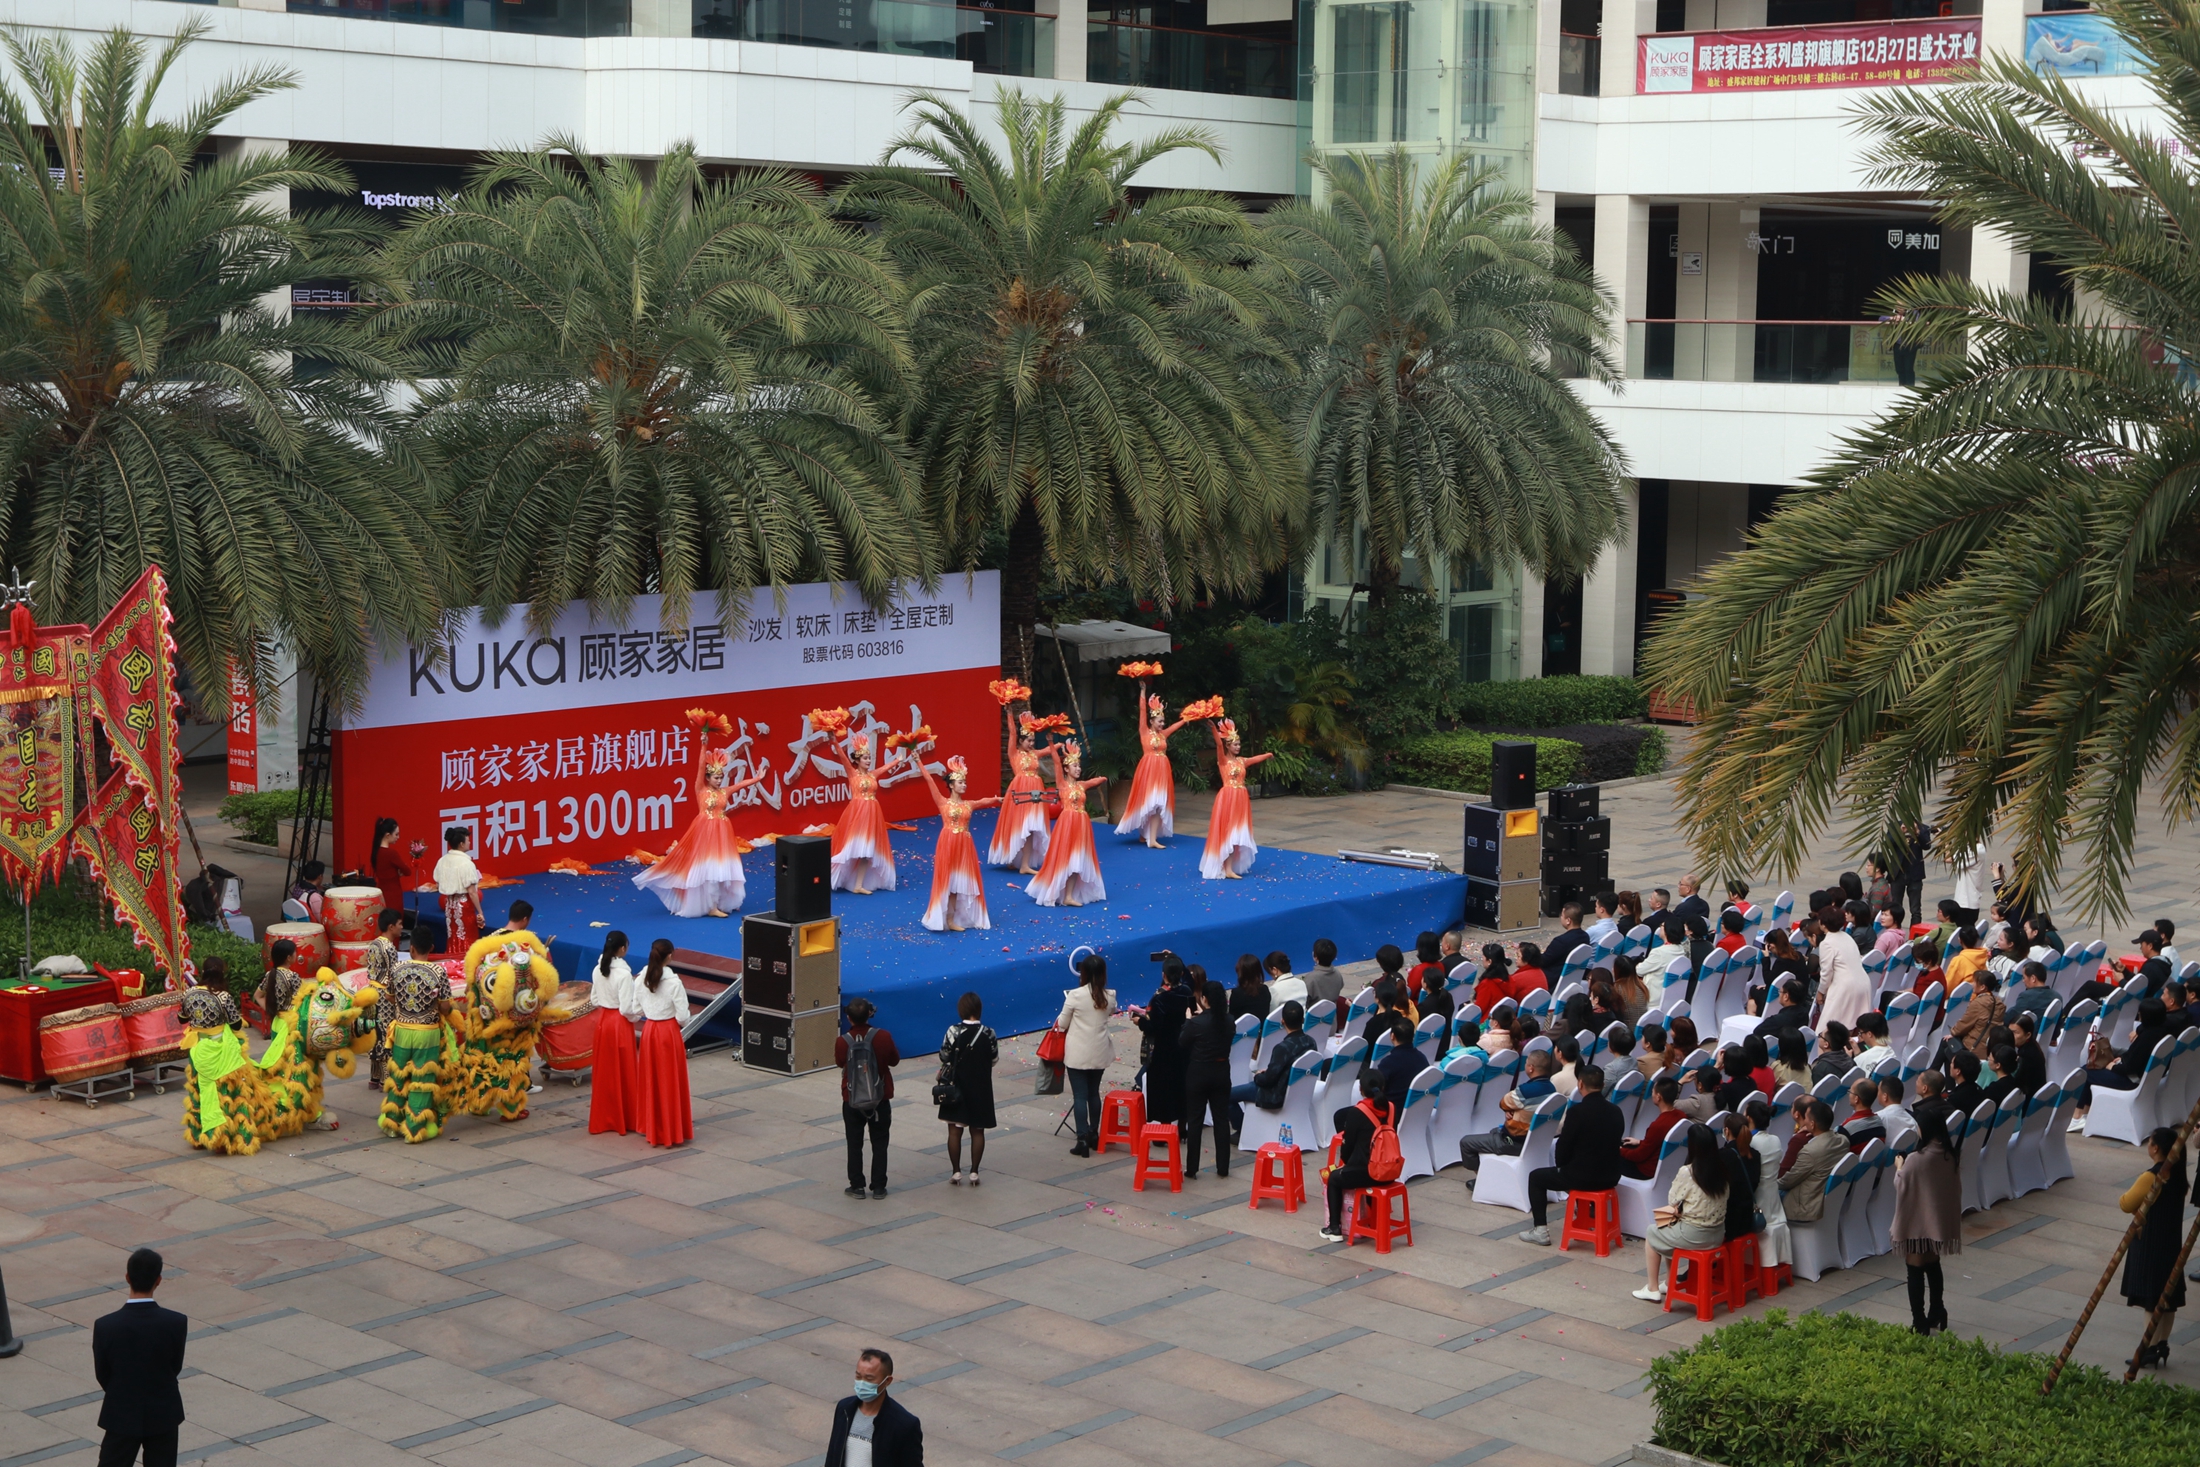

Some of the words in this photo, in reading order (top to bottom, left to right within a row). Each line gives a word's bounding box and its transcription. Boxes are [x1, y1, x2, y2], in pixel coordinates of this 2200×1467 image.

[1650, 66, 1689, 78] 顾家家居
[1904, 232, 1940, 250] 美加
[748, 616, 783, 643] 沙发
[796, 614, 831, 639] 软床
[843, 609, 877, 635] 床垫
[890, 602, 954, 631] 全屋定制
[578, 624, 726, 683] 顾家家居
[802, 643, 854, 664] 股票代码
[857, 639, 904, 658] 603816
[440, 724, 691, 793] 顾家家居旗舰店
[789, 783, 853, 808] OPENIN
